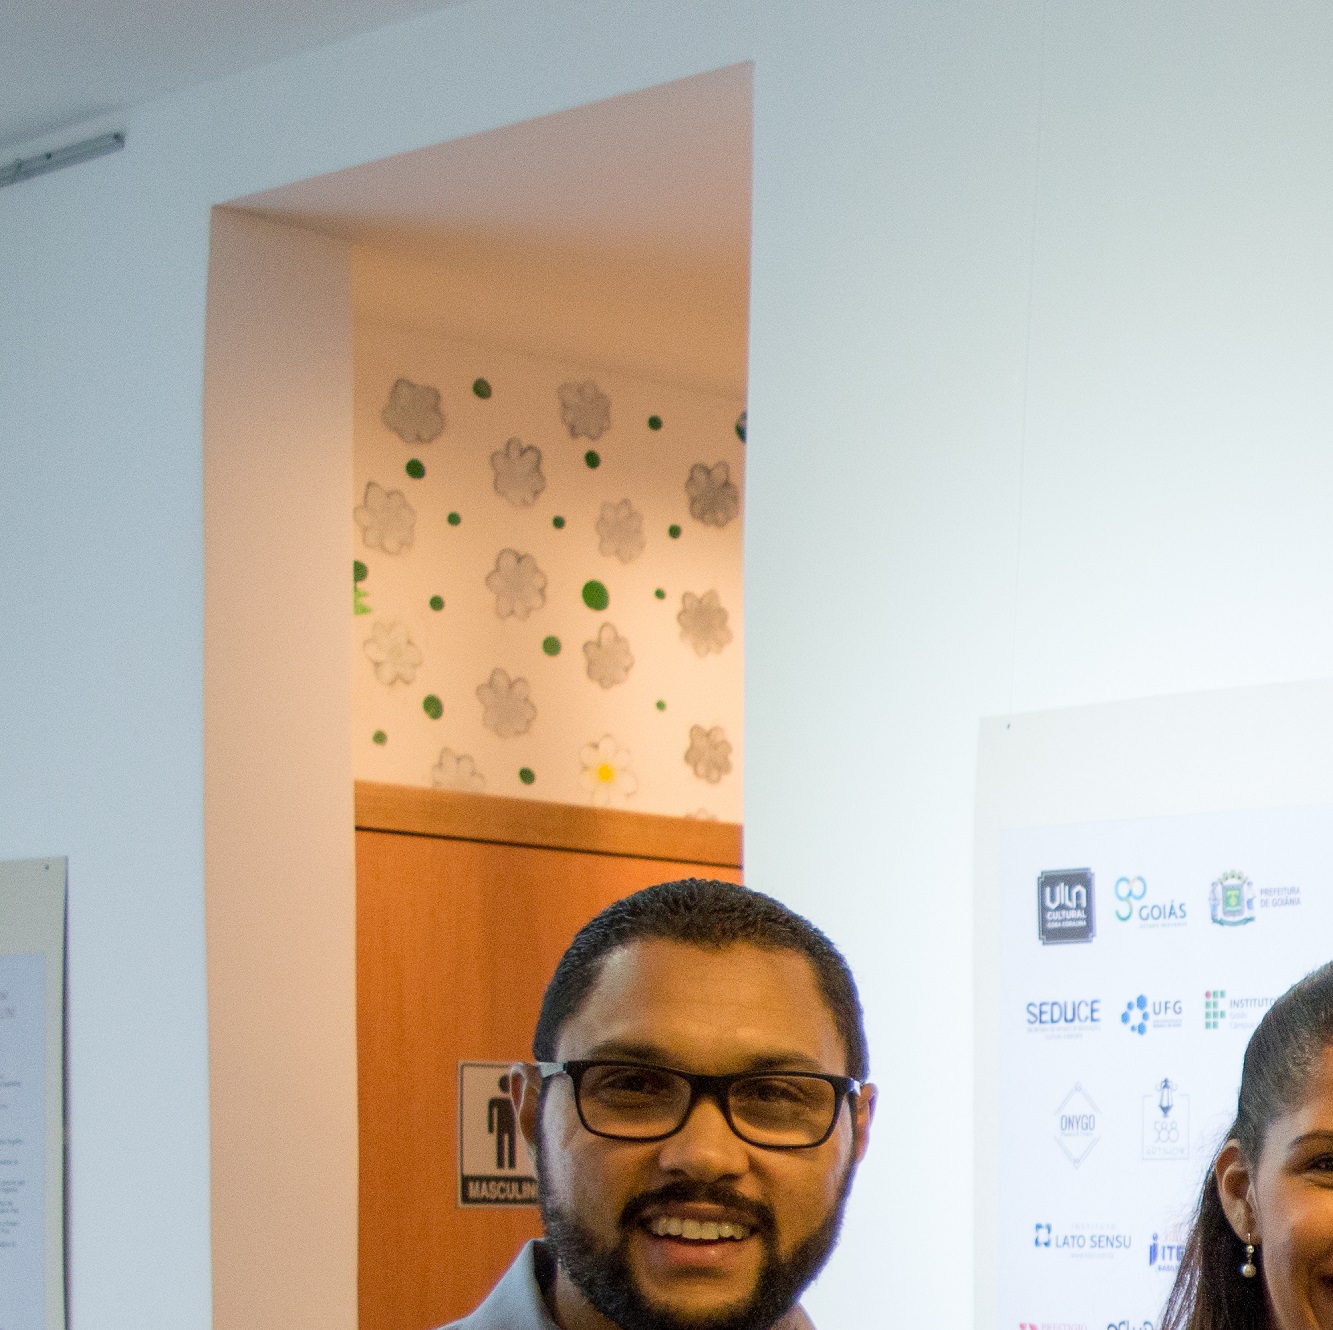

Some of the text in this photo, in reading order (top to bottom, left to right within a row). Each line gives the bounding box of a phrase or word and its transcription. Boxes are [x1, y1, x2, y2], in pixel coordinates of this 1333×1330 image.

[1260, 886, 1300, 897] PREFEITURA
[1138, 899, 1187, 921] GOIÁS
[1260, 896, 1301, 908] DE GOIÂNIA
[1046, 909, 1087, 921] CULTURAL
[1026, 999, 1101, 1025] SEDUCE
[1152, 1000, 1182, 1016] UFG
[1060, 1114, 1095, 1131] ONYGO
[468, 1180, 538, 1200] MASCULIN
[1055, 1233, 1132, 1249] LATO SENSU
